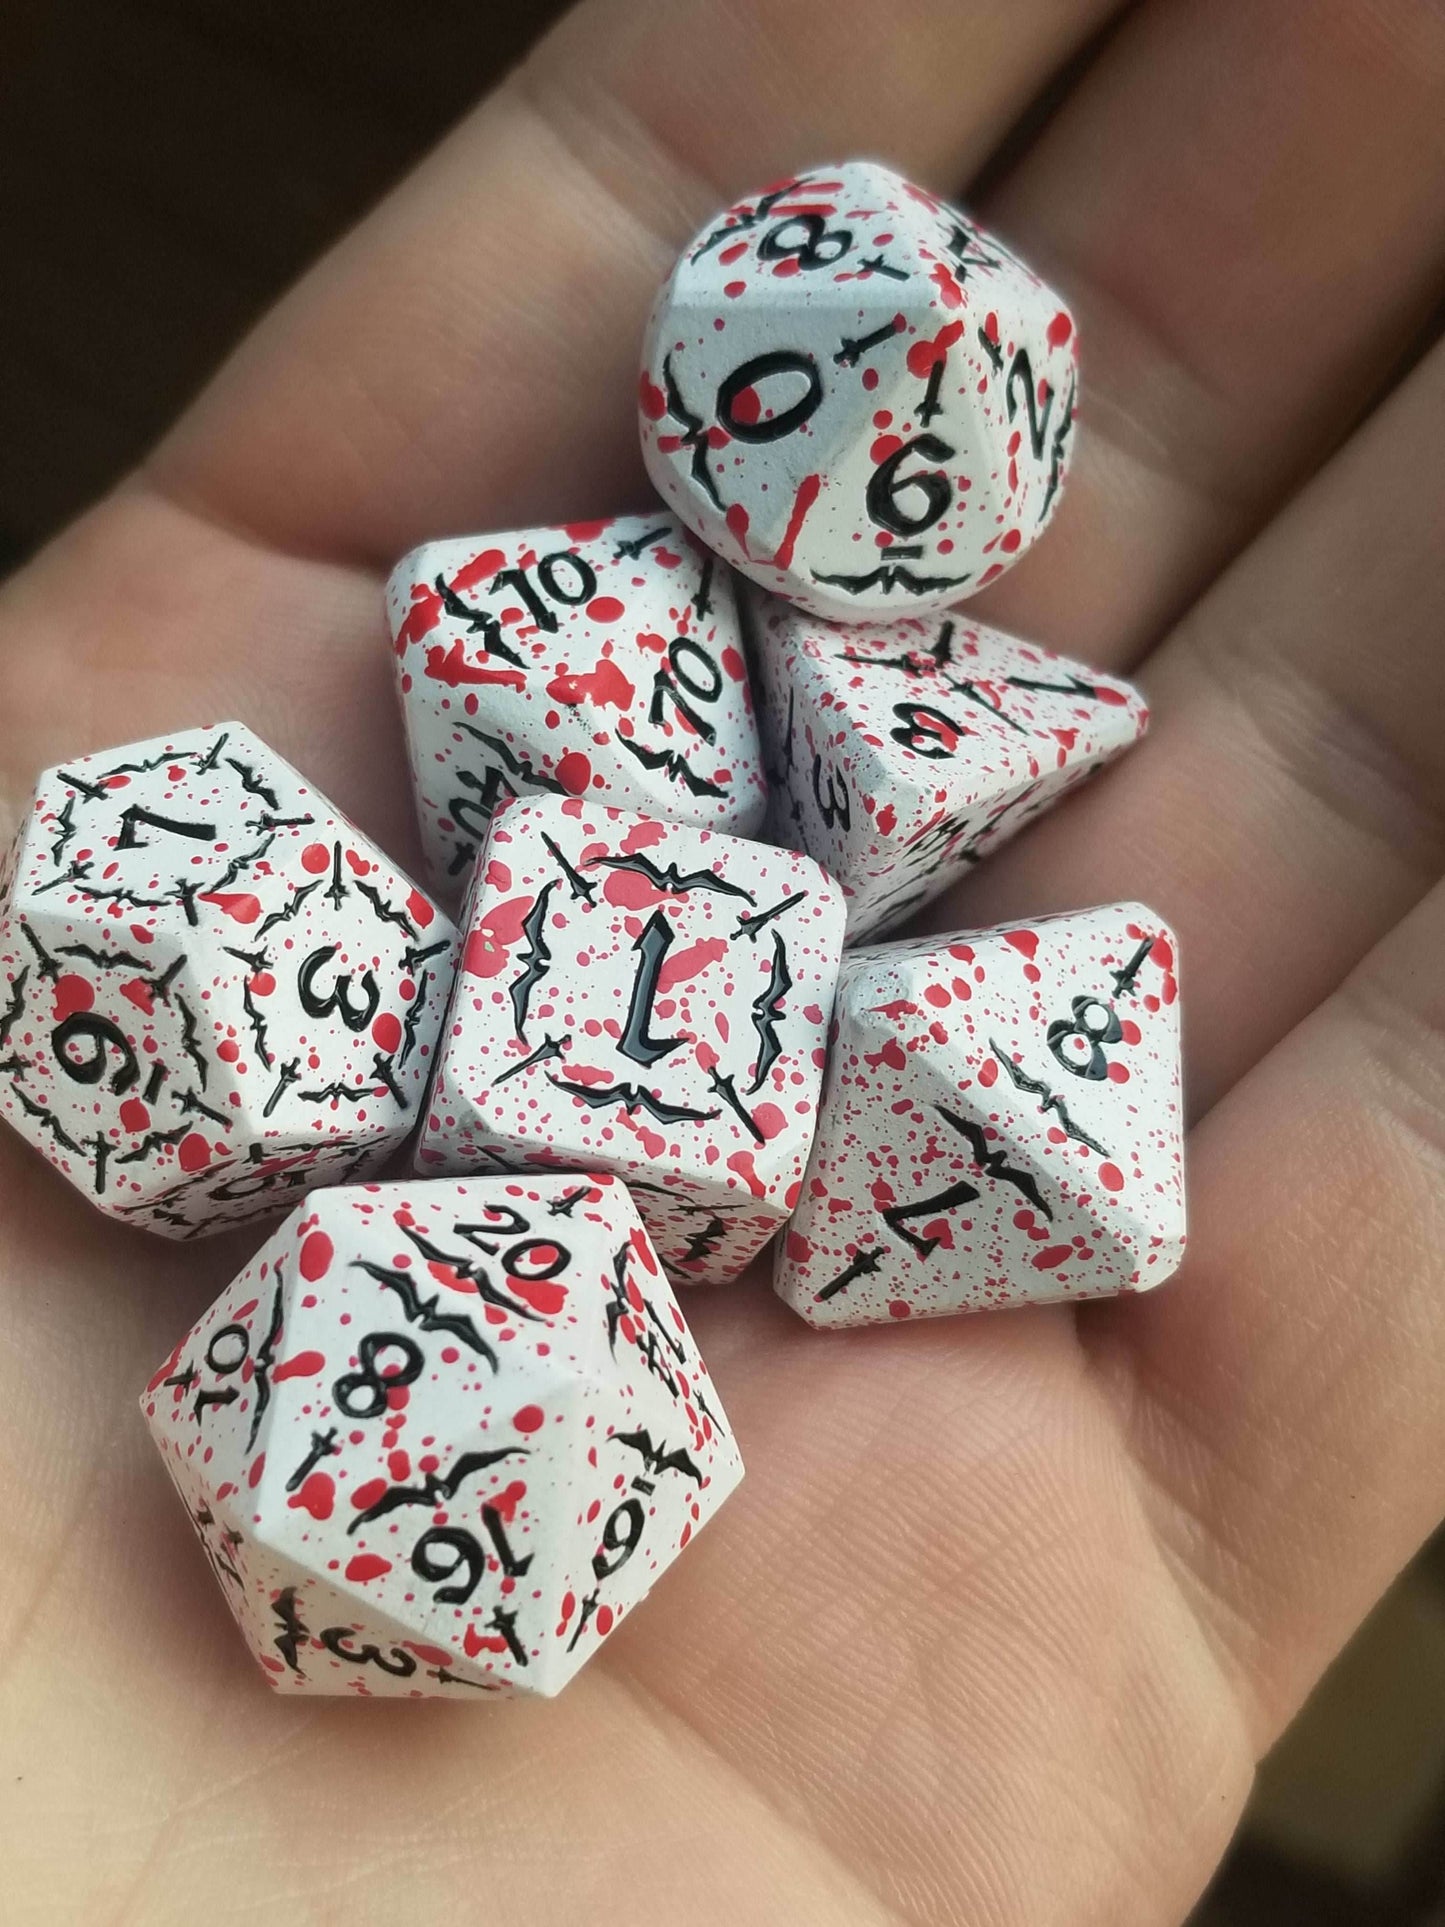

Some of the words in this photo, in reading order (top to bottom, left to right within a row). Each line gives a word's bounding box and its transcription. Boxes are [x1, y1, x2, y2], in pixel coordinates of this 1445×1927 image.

[757, 214, 853, 270] 8
[716, 350, 823, 444] 0
[1006, 348, 1054, 461] 2
[866, 433, 955, 537] 6
[488, 551, 597, 634] 10
[648, 636, 723, 747] 70
[889, 702, 965, 760] 3
[115, 804, 217, 850] 7
[813, 754, 850, 833] 3
[298, 945, 381, 1033] 3
[616, 909, 693, 1069] 1
[51, 1011, 140, 1097] 9
[1046, 994, 1123, 1081] 8
[454, 1204, 572, 1281] 20
[882, 1180, 981, 1257] 7
[193, 1323, 249, 1427] 10
[333, 1332, 425, 1419] 8
[411, 1503, 534, 1605] 16
[591, 1498, 645, 1581] 6
[319, 1626, 417, 1678] 3
